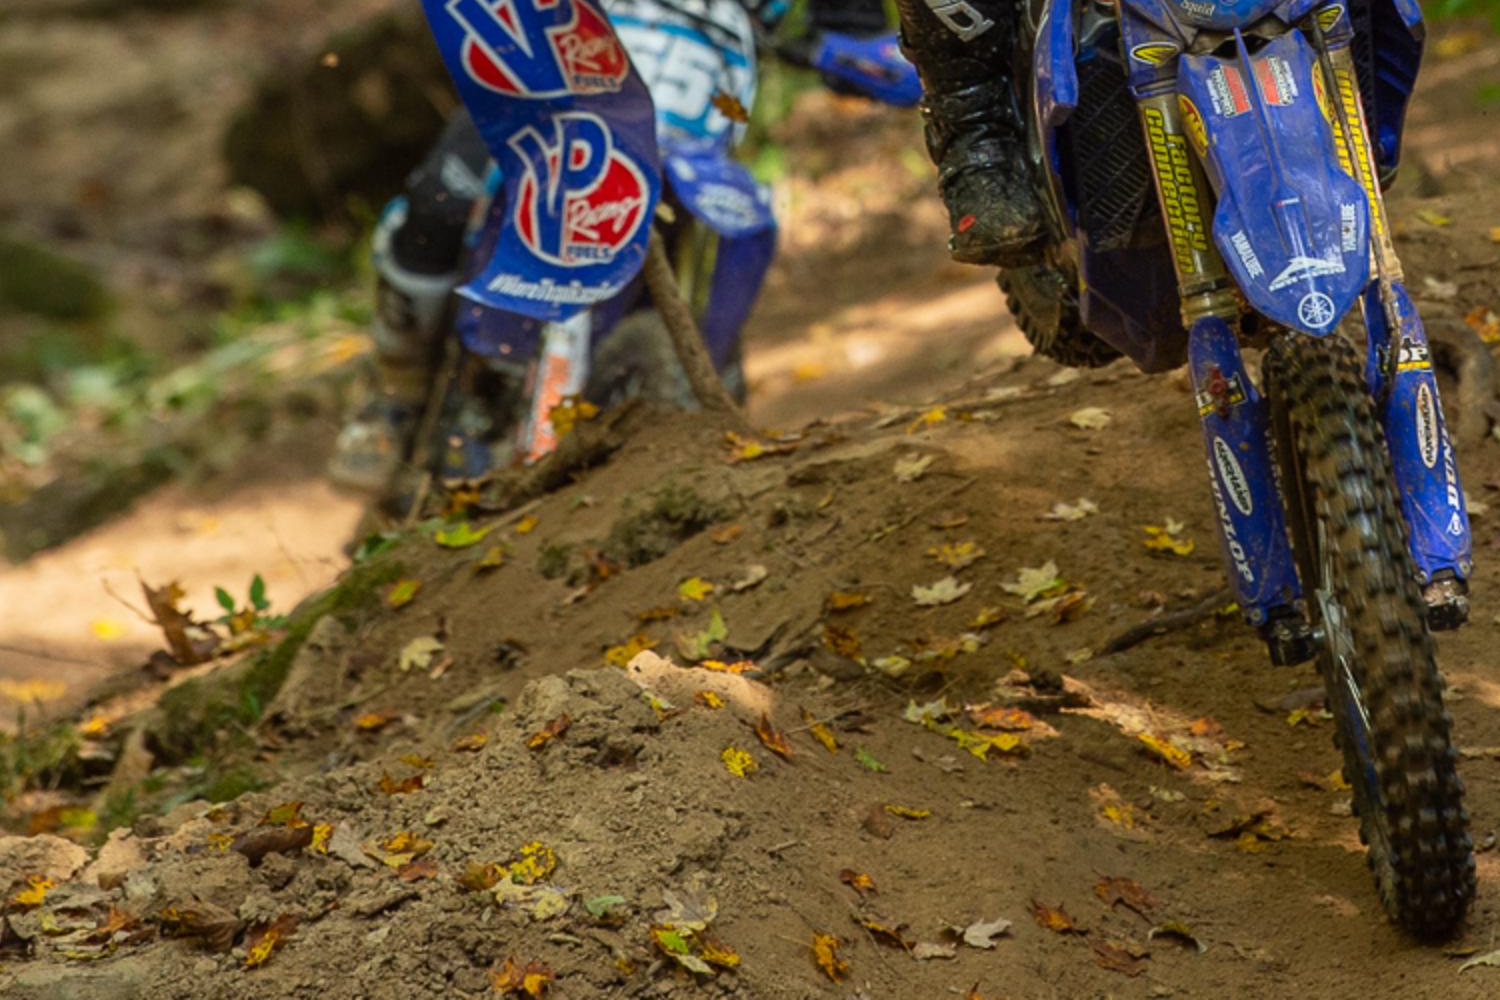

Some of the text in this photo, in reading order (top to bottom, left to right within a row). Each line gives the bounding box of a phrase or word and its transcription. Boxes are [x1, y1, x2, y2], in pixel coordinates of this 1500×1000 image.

[506, 111, 613, 265] VP
[1144, 107, 1196, 274] Connection
[1166, 133, 1208, 252] Factory
